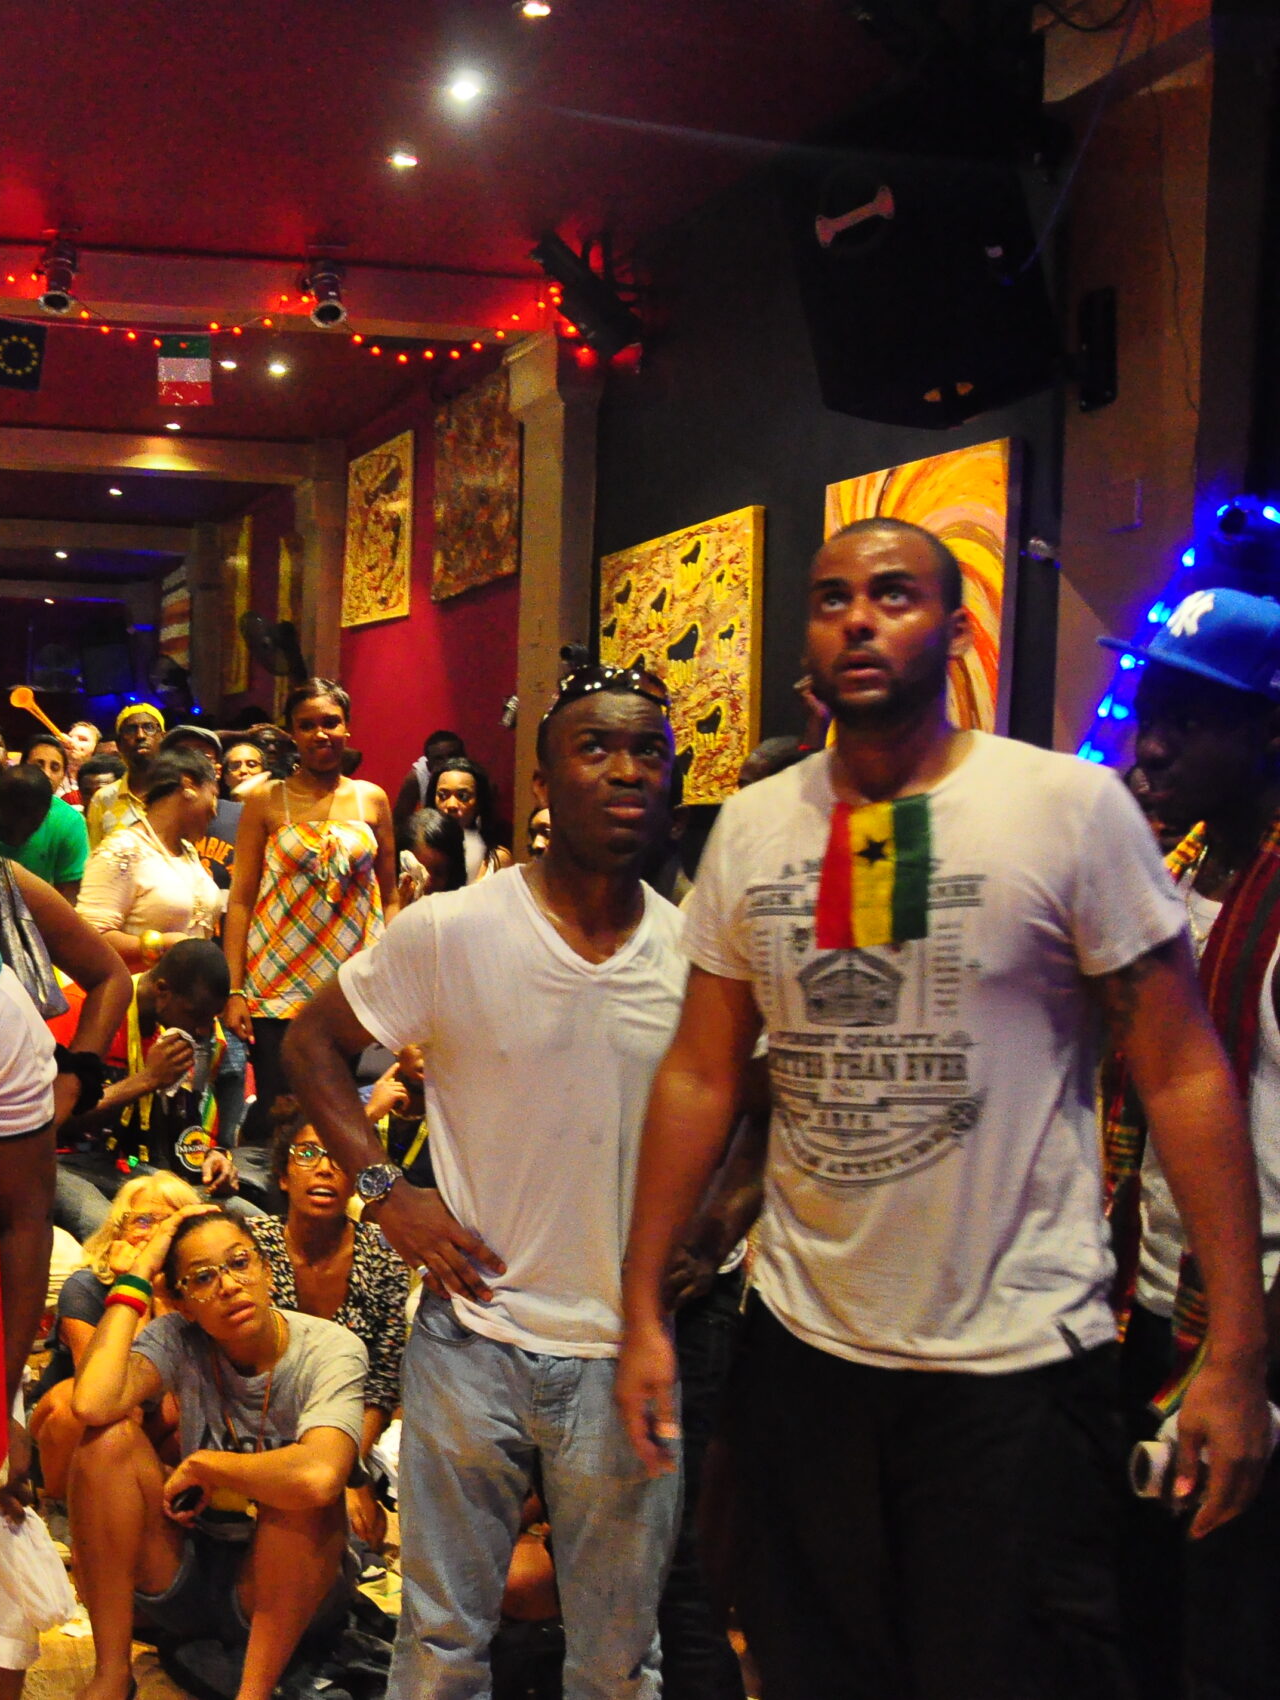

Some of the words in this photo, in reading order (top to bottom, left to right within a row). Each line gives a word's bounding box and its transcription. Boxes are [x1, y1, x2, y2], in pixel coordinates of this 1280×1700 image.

[1166, 590, 1215, 637] NY
[833, 1052, 897, 1081] THAN
[906, 1053, 968, 1082] EVER
